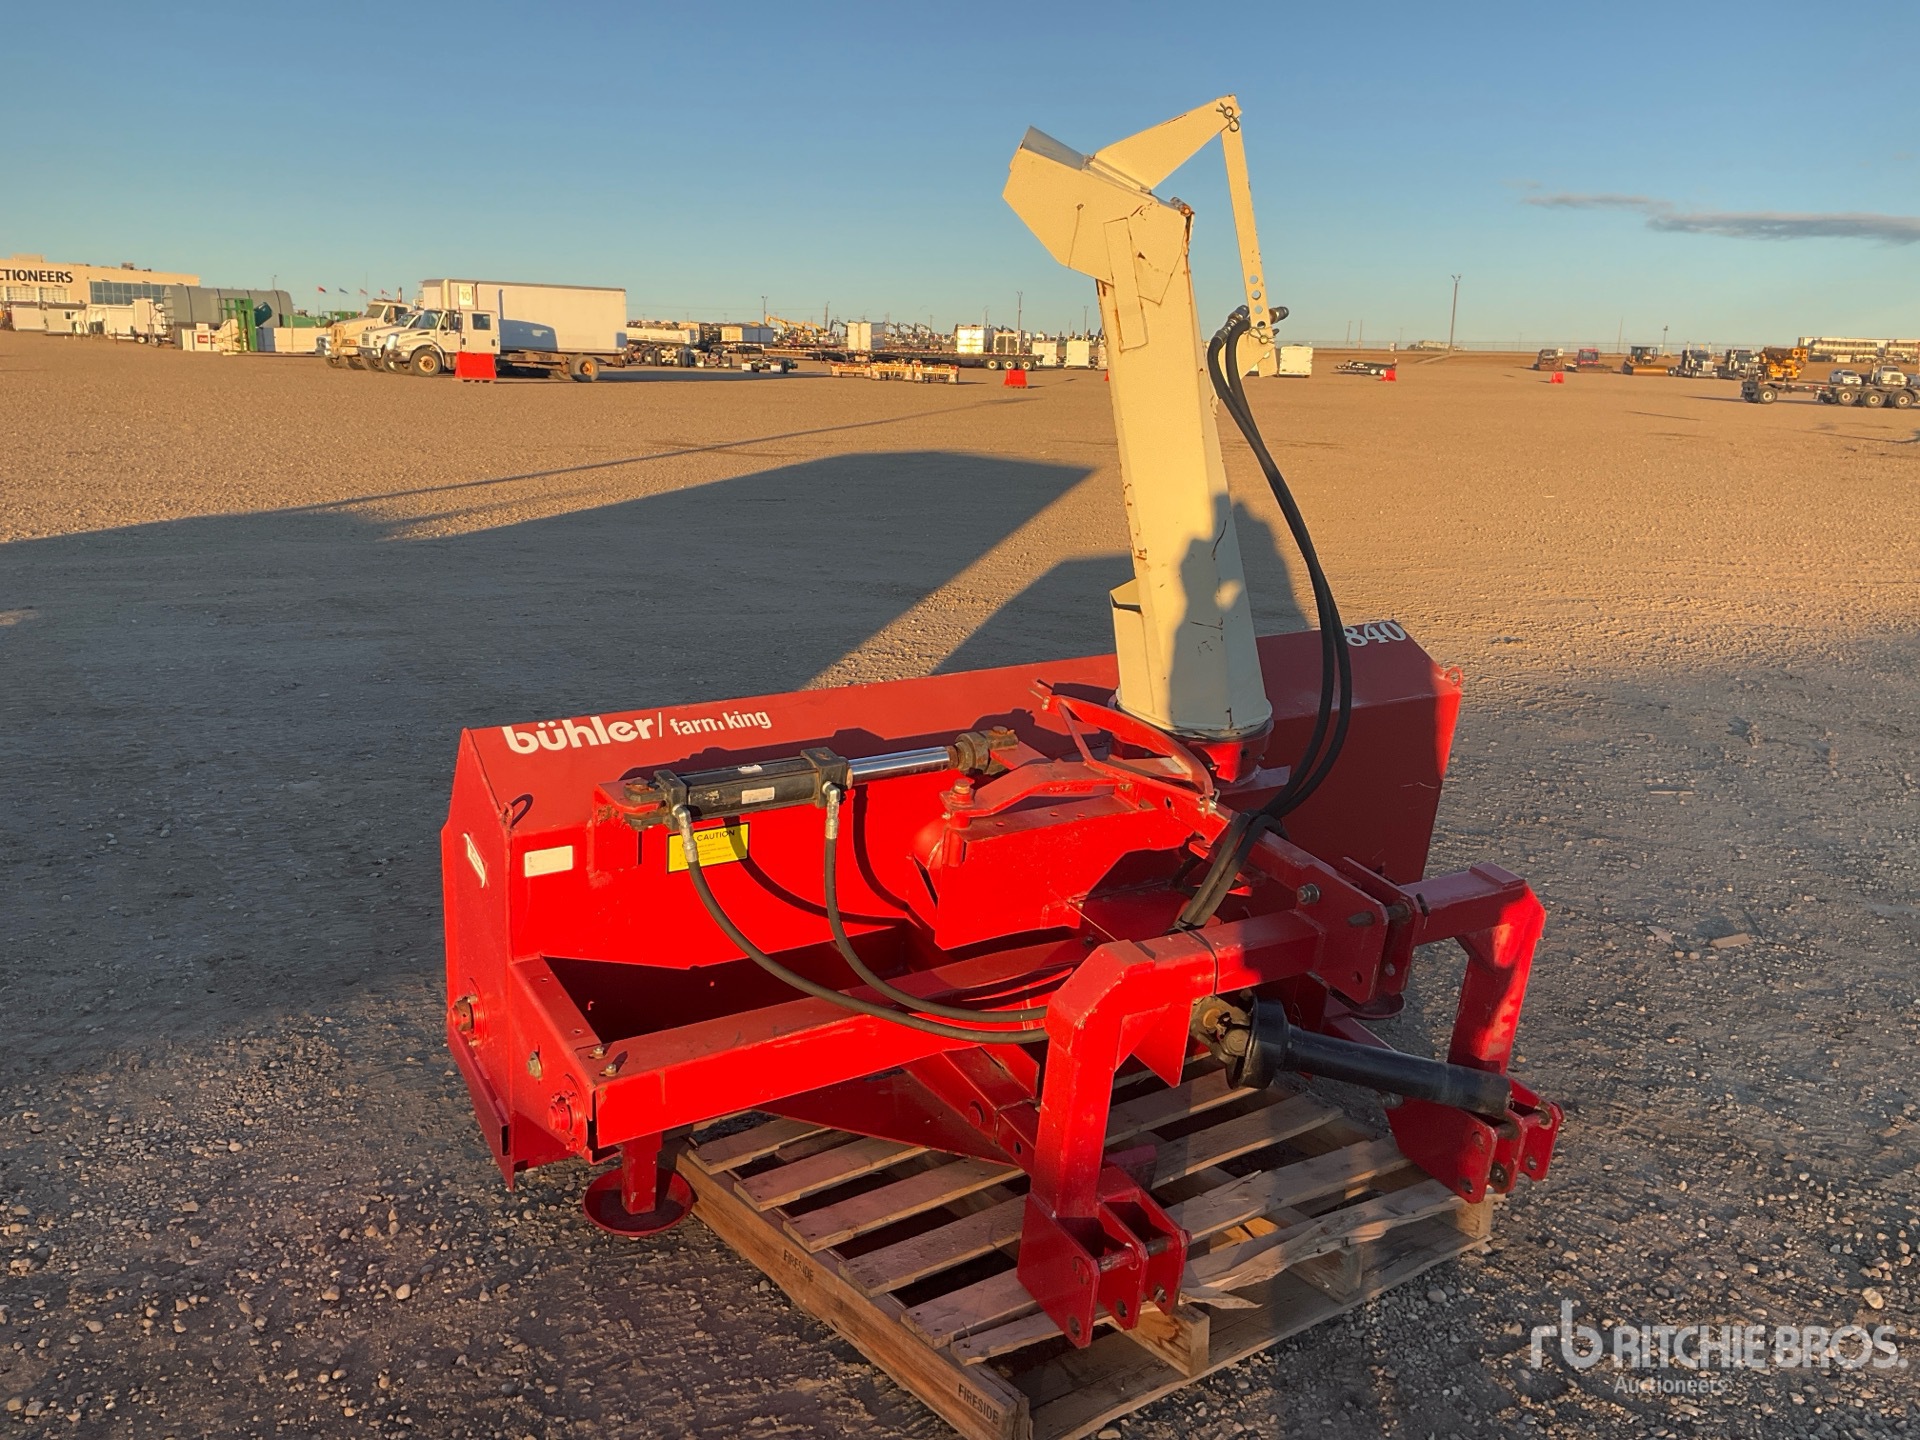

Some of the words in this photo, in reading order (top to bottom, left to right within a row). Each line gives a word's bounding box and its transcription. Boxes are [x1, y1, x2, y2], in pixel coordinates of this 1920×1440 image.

[502, 716, 653, 754] bühler
[722, 710, 772, 729] king
[696, 829, 735, 842] CAUTION
[958, 1383, 999, 1426] FIRESIDE
